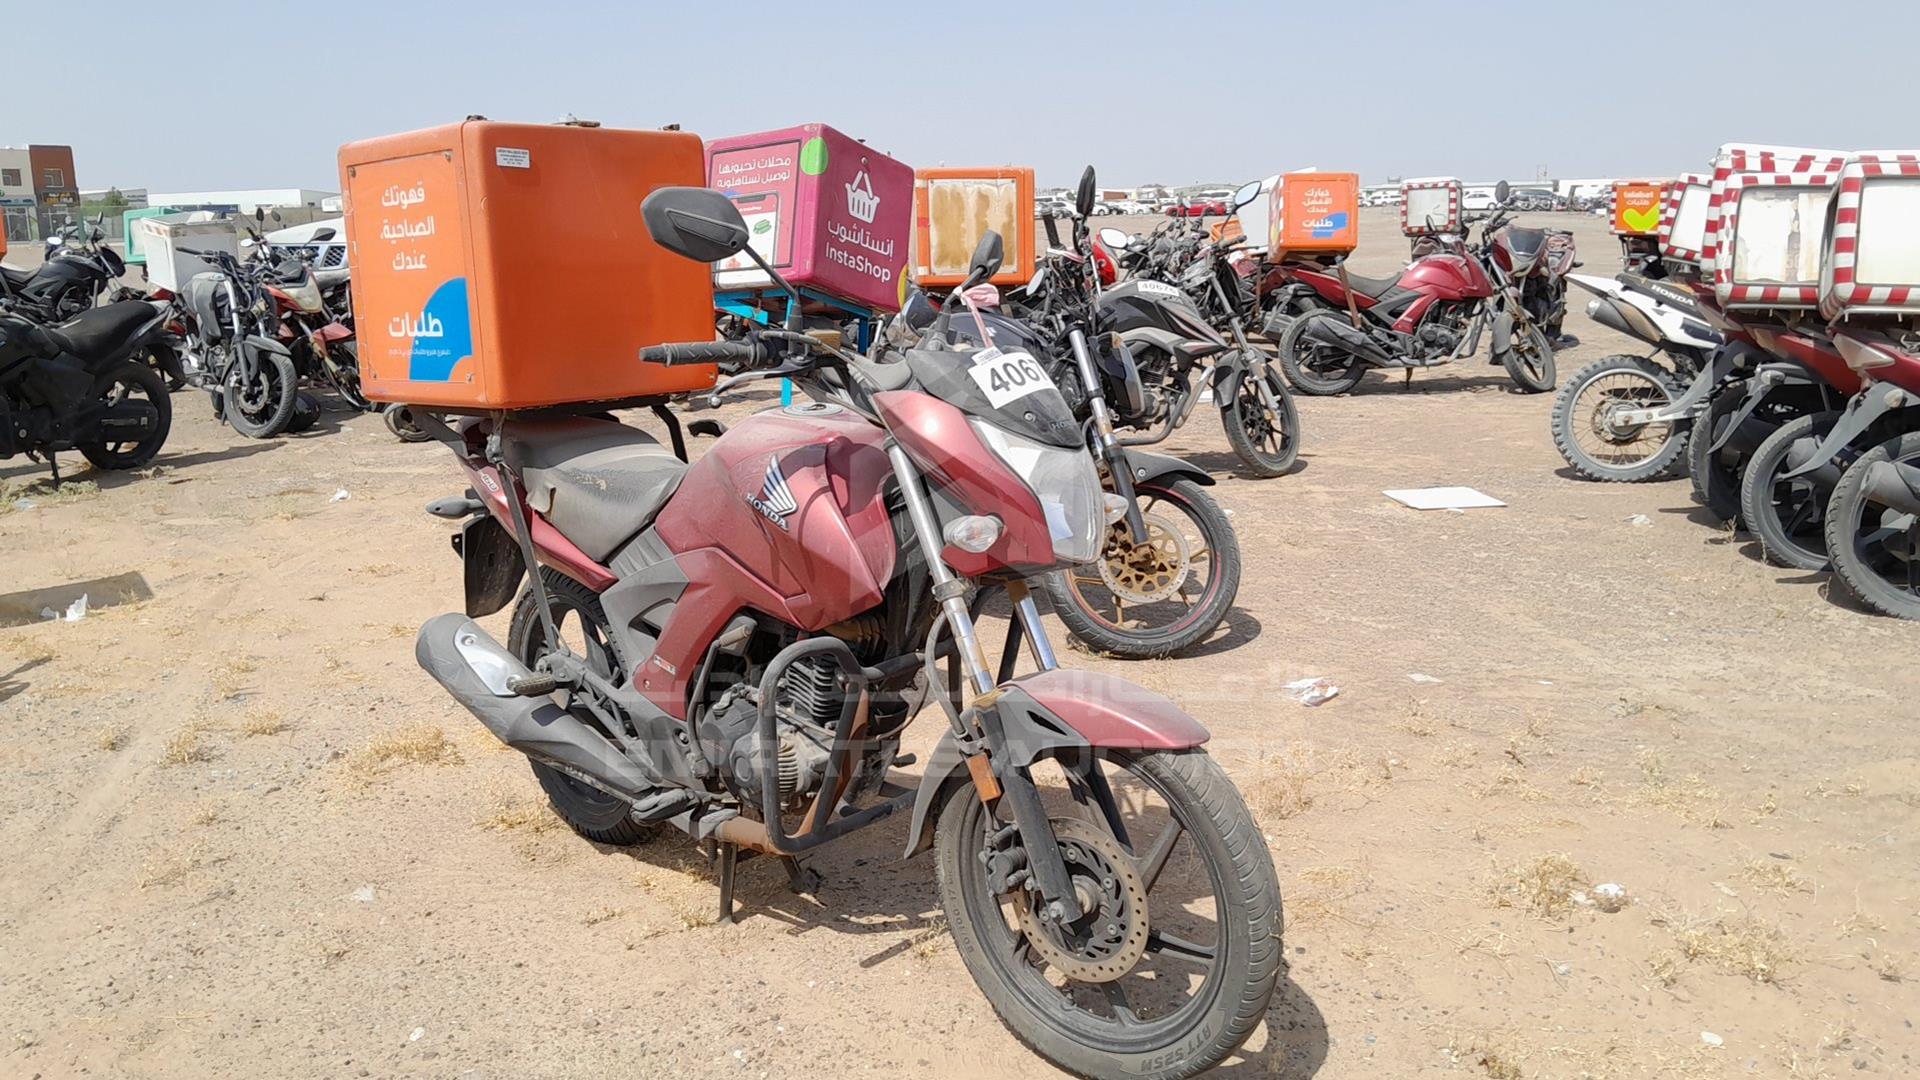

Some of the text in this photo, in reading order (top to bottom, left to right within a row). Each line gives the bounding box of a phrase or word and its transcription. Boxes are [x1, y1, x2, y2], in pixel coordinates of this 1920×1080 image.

[757, 156, 792, 169] محلات
[381, 181, 425, 210] قهوتك
[1302, 217, 1334, 228] طلبات
[827, 219, 894, 262] إنستاشوب
[391, 249, 428, 271] عندك
[825, 241, 892, 283] InstaShop
[1651, 284, 1695, 306] HONDA
[388, 310, 444, 345] طلبات
[745, 493, 788, 530] HONDA
